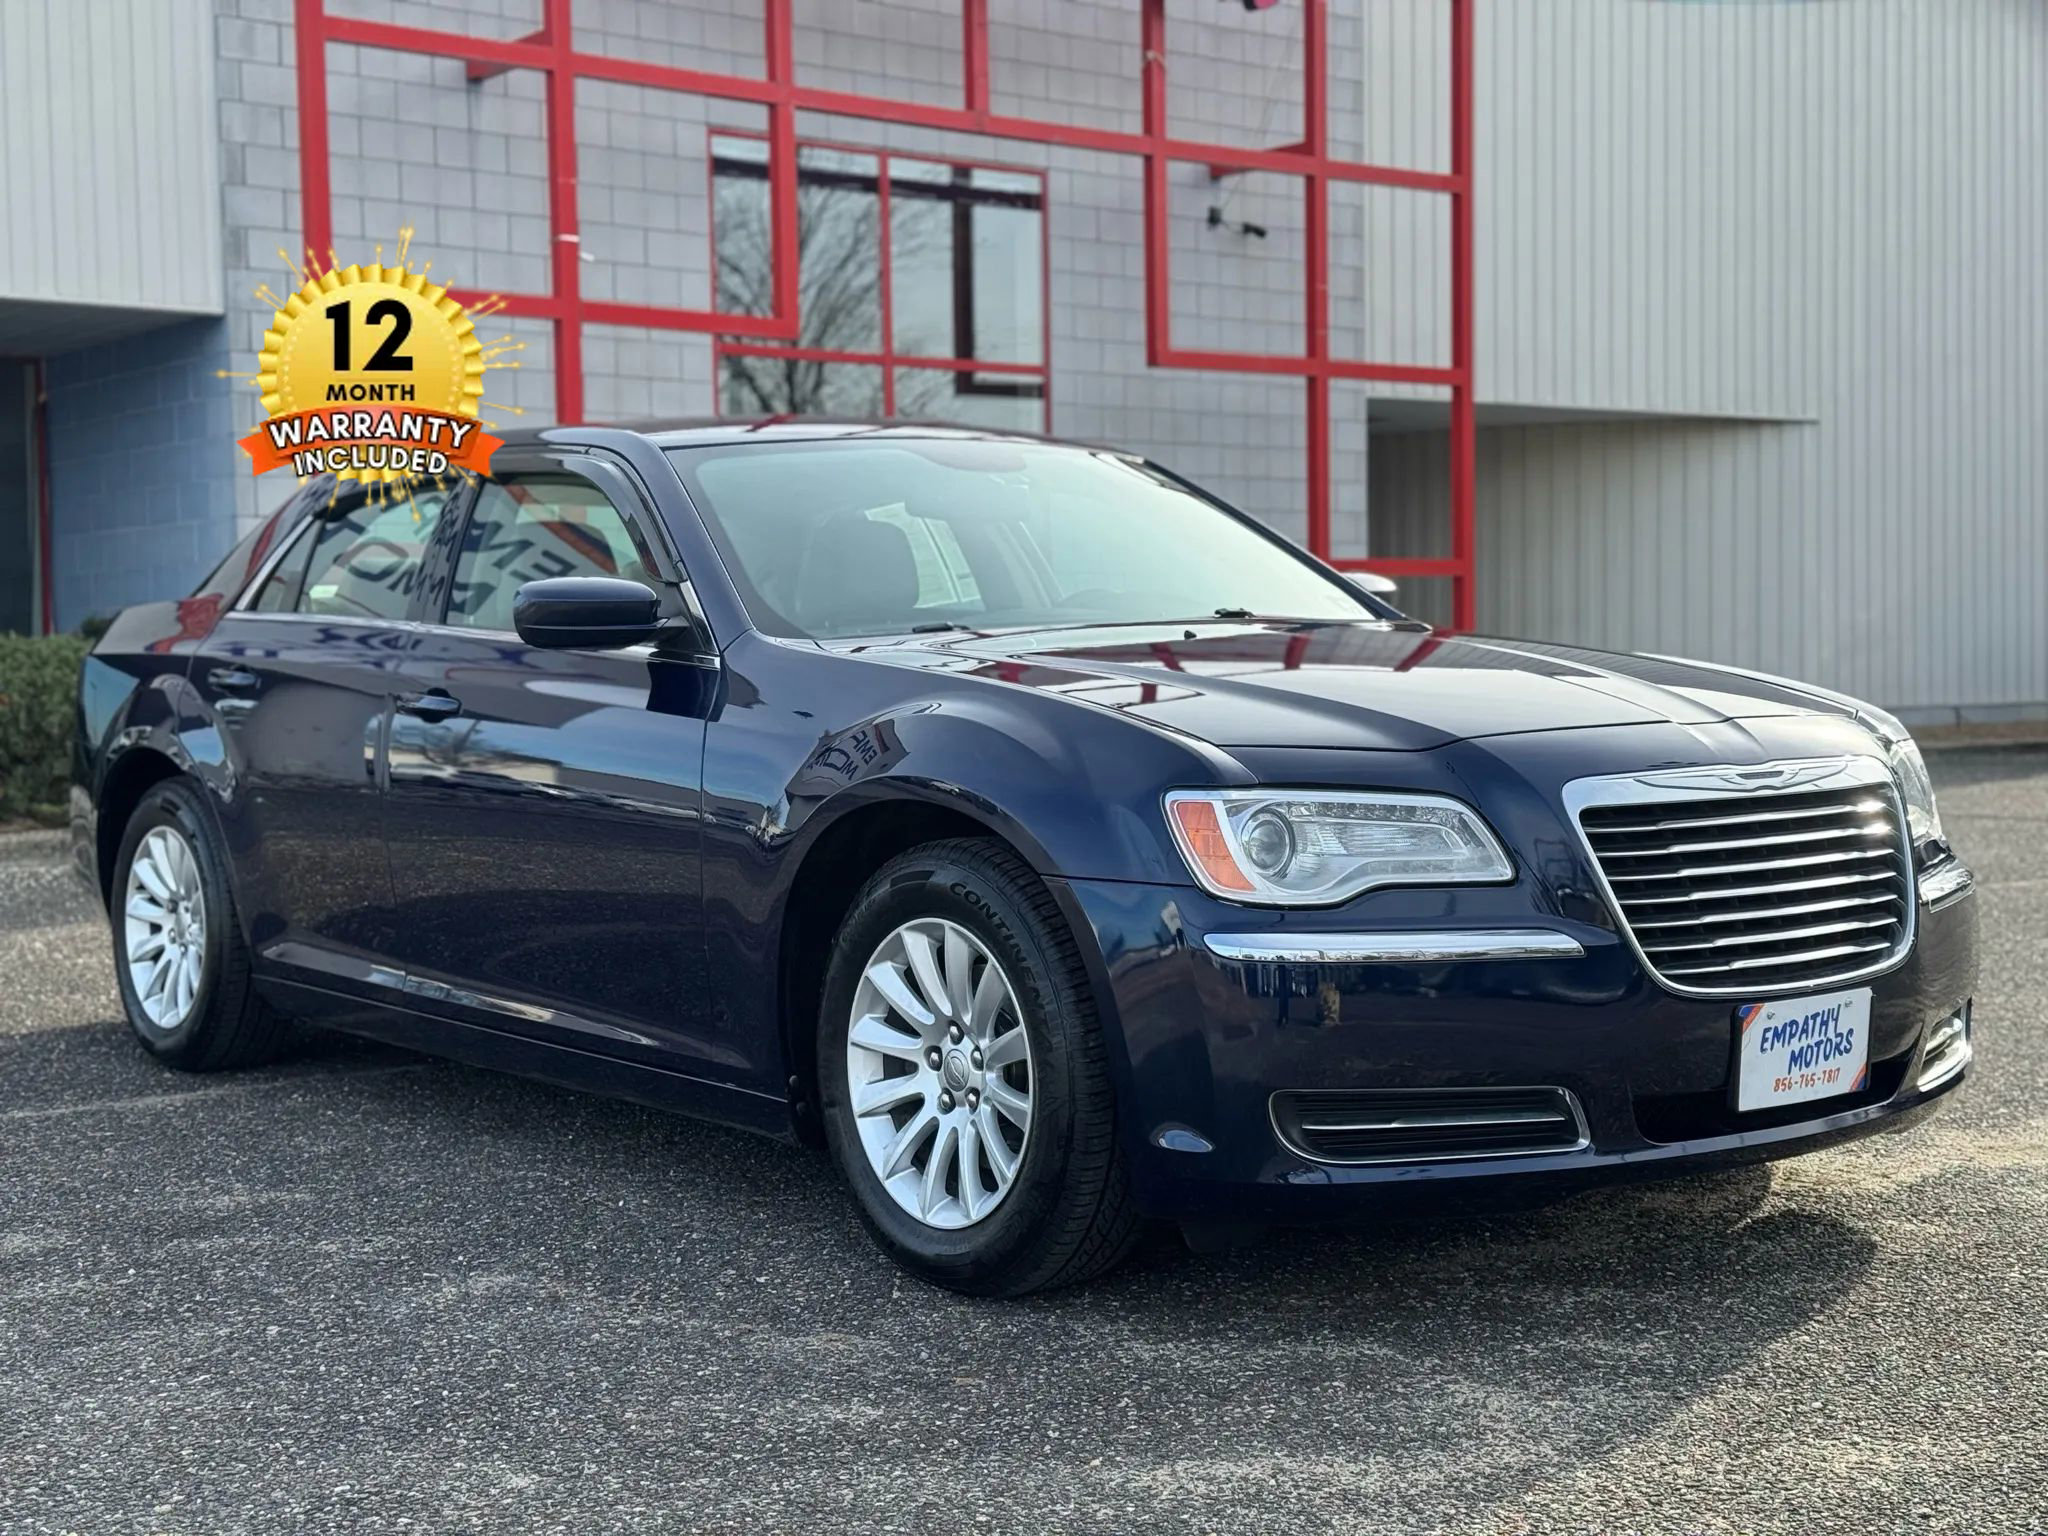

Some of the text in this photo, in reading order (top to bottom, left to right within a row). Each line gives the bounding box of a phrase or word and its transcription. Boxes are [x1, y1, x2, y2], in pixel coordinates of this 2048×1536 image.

[1760, 1003, 1841, 1054] EMPATHY
[1788, 1028, 1854, 1075] MOTORS
[1773, 1067, 1840, 1093] 856-765-7817
